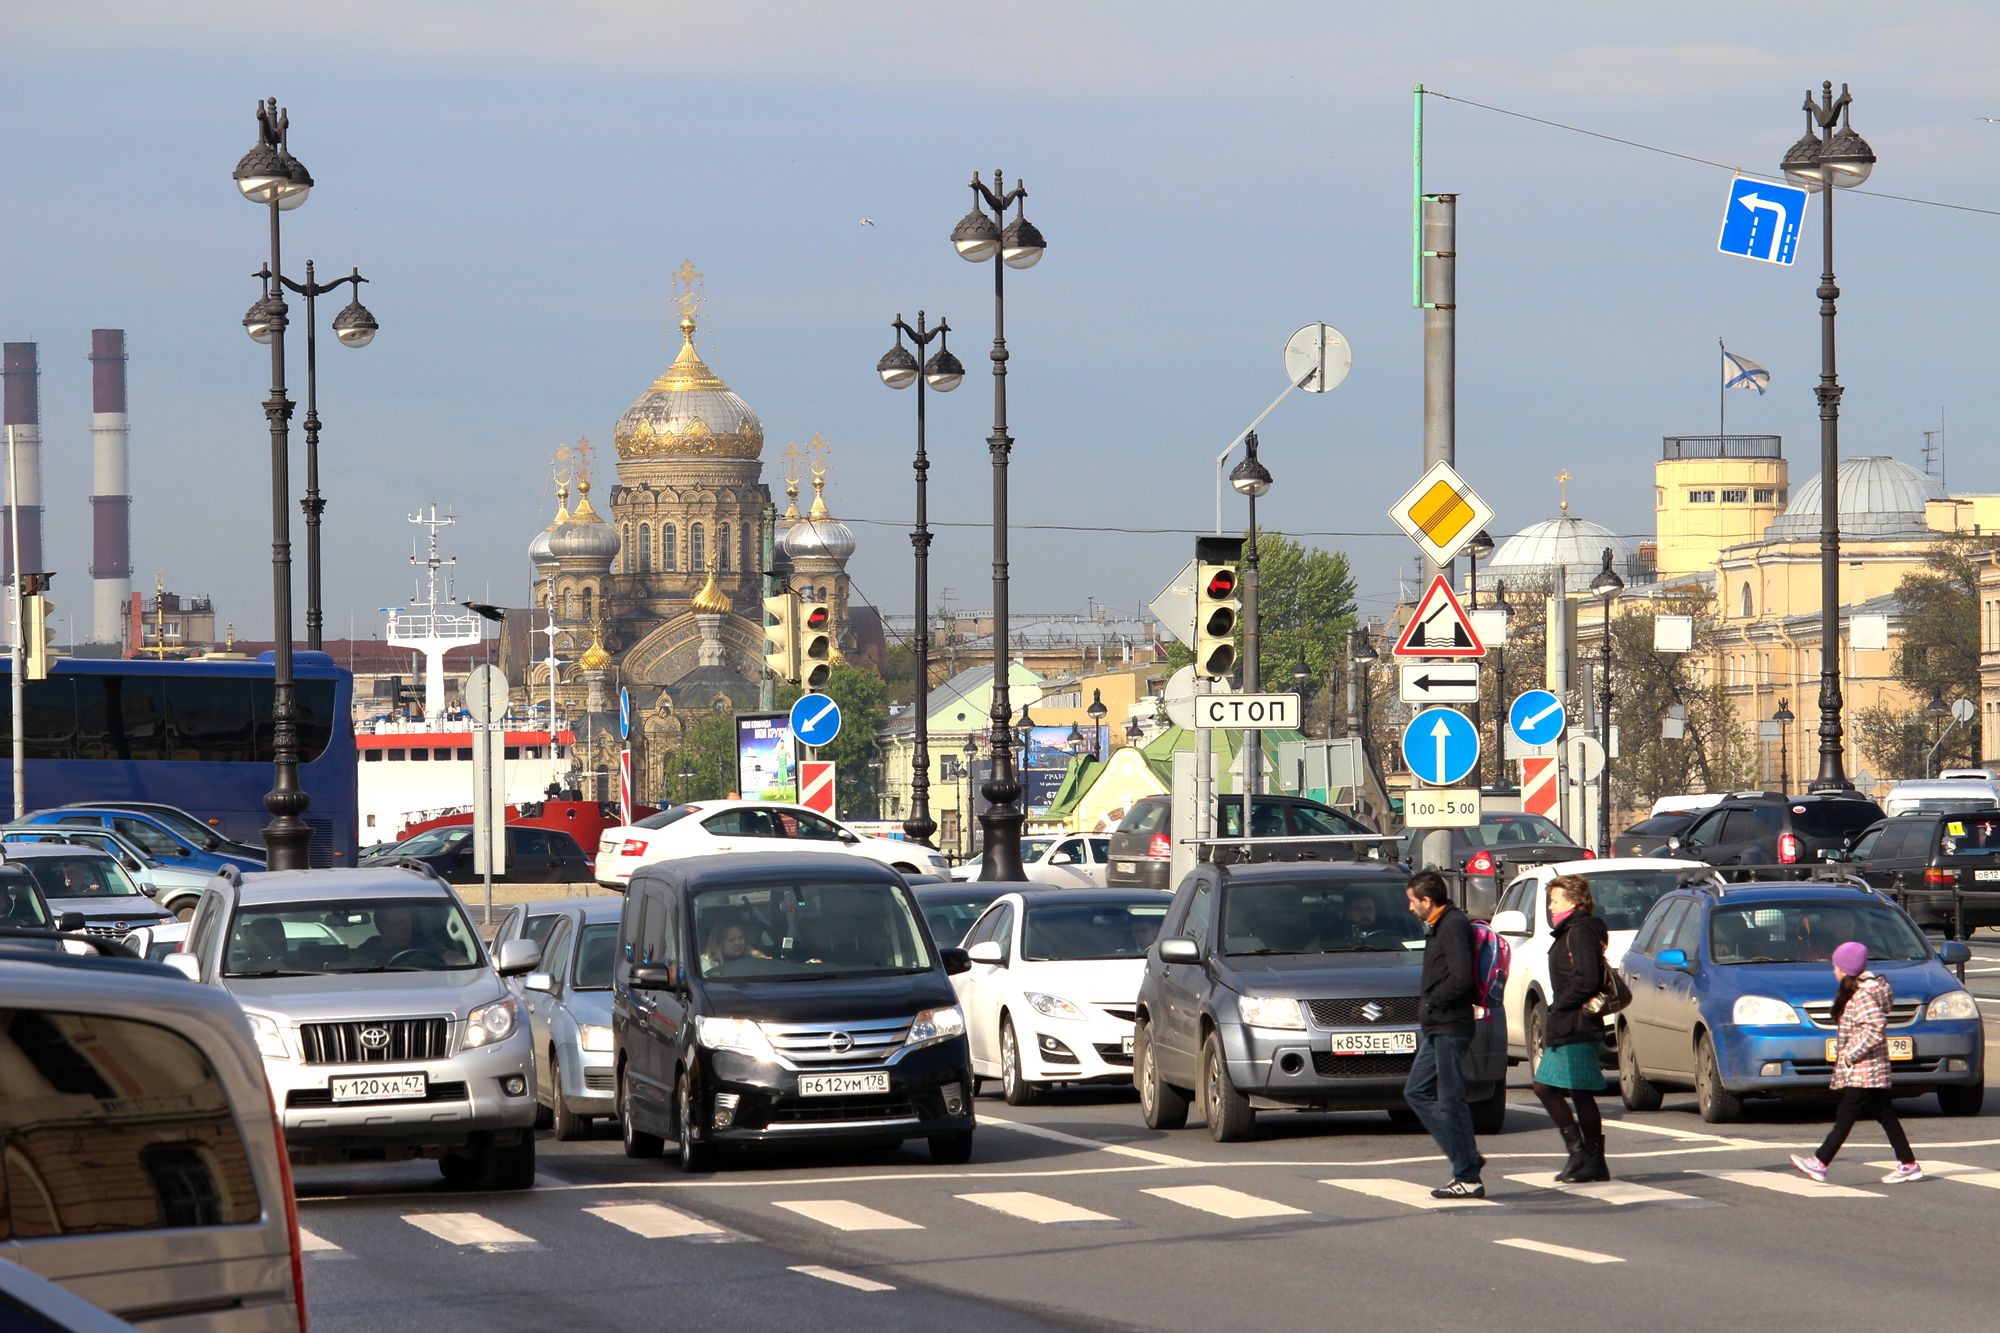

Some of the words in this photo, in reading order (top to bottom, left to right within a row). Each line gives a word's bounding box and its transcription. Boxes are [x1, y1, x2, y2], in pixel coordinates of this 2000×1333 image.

[1209, 701, 1285, 722] СТОП
[404, 1076, 419, 1088] 47
[805, 1077, 862, 1093] Р612УМ
[864, 1075, 884, 1086] 178
